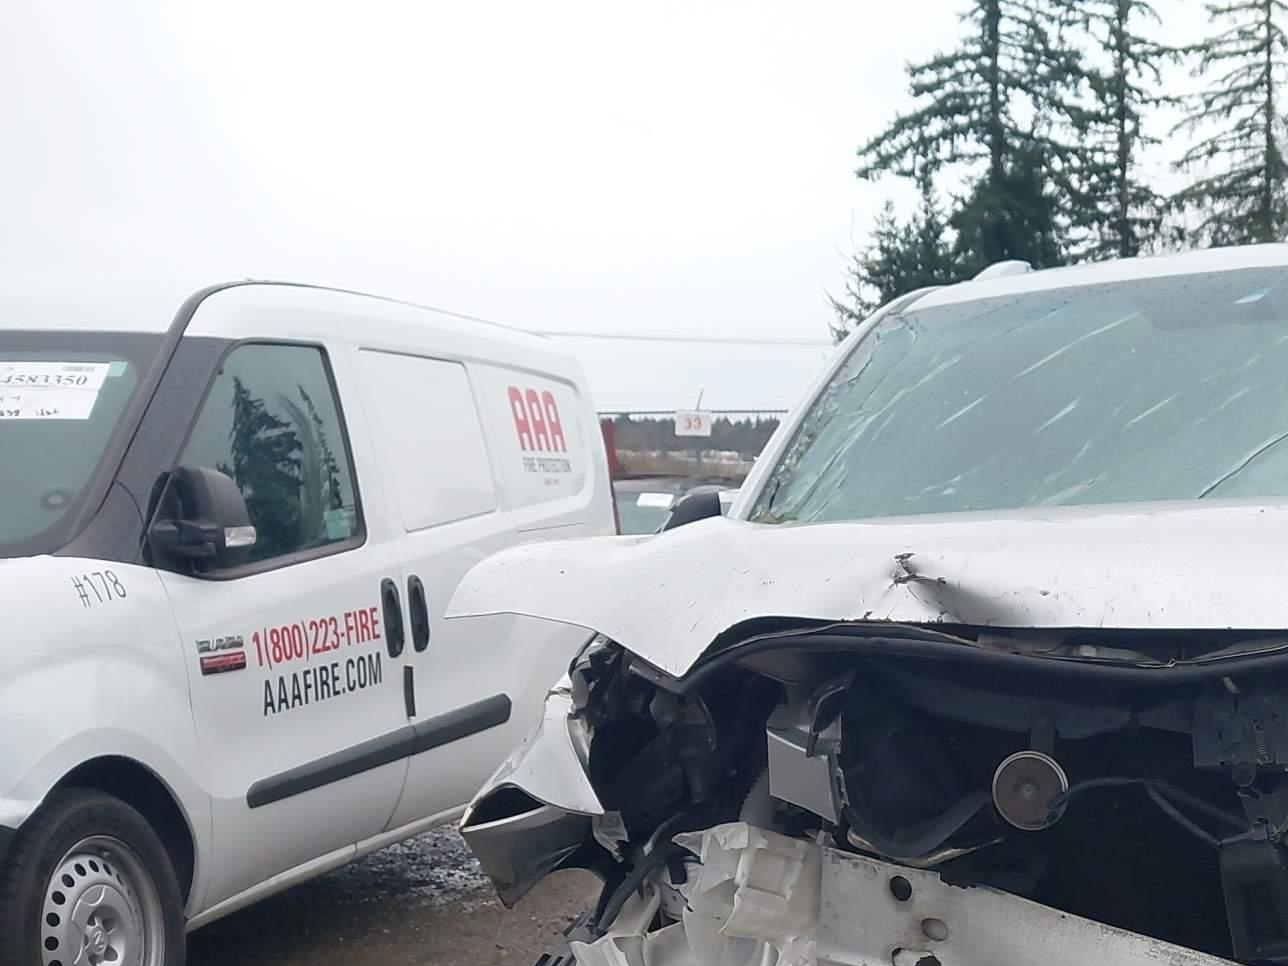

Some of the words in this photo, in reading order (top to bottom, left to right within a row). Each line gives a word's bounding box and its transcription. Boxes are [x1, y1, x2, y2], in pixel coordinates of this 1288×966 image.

[508, 386, 567, 453] AAA
[70, 570, 126, 608] #178
[252, 607, 381, 670] 1(800)223-FIRE
[264, 651, 383, 717] AAAFIRE.COM
